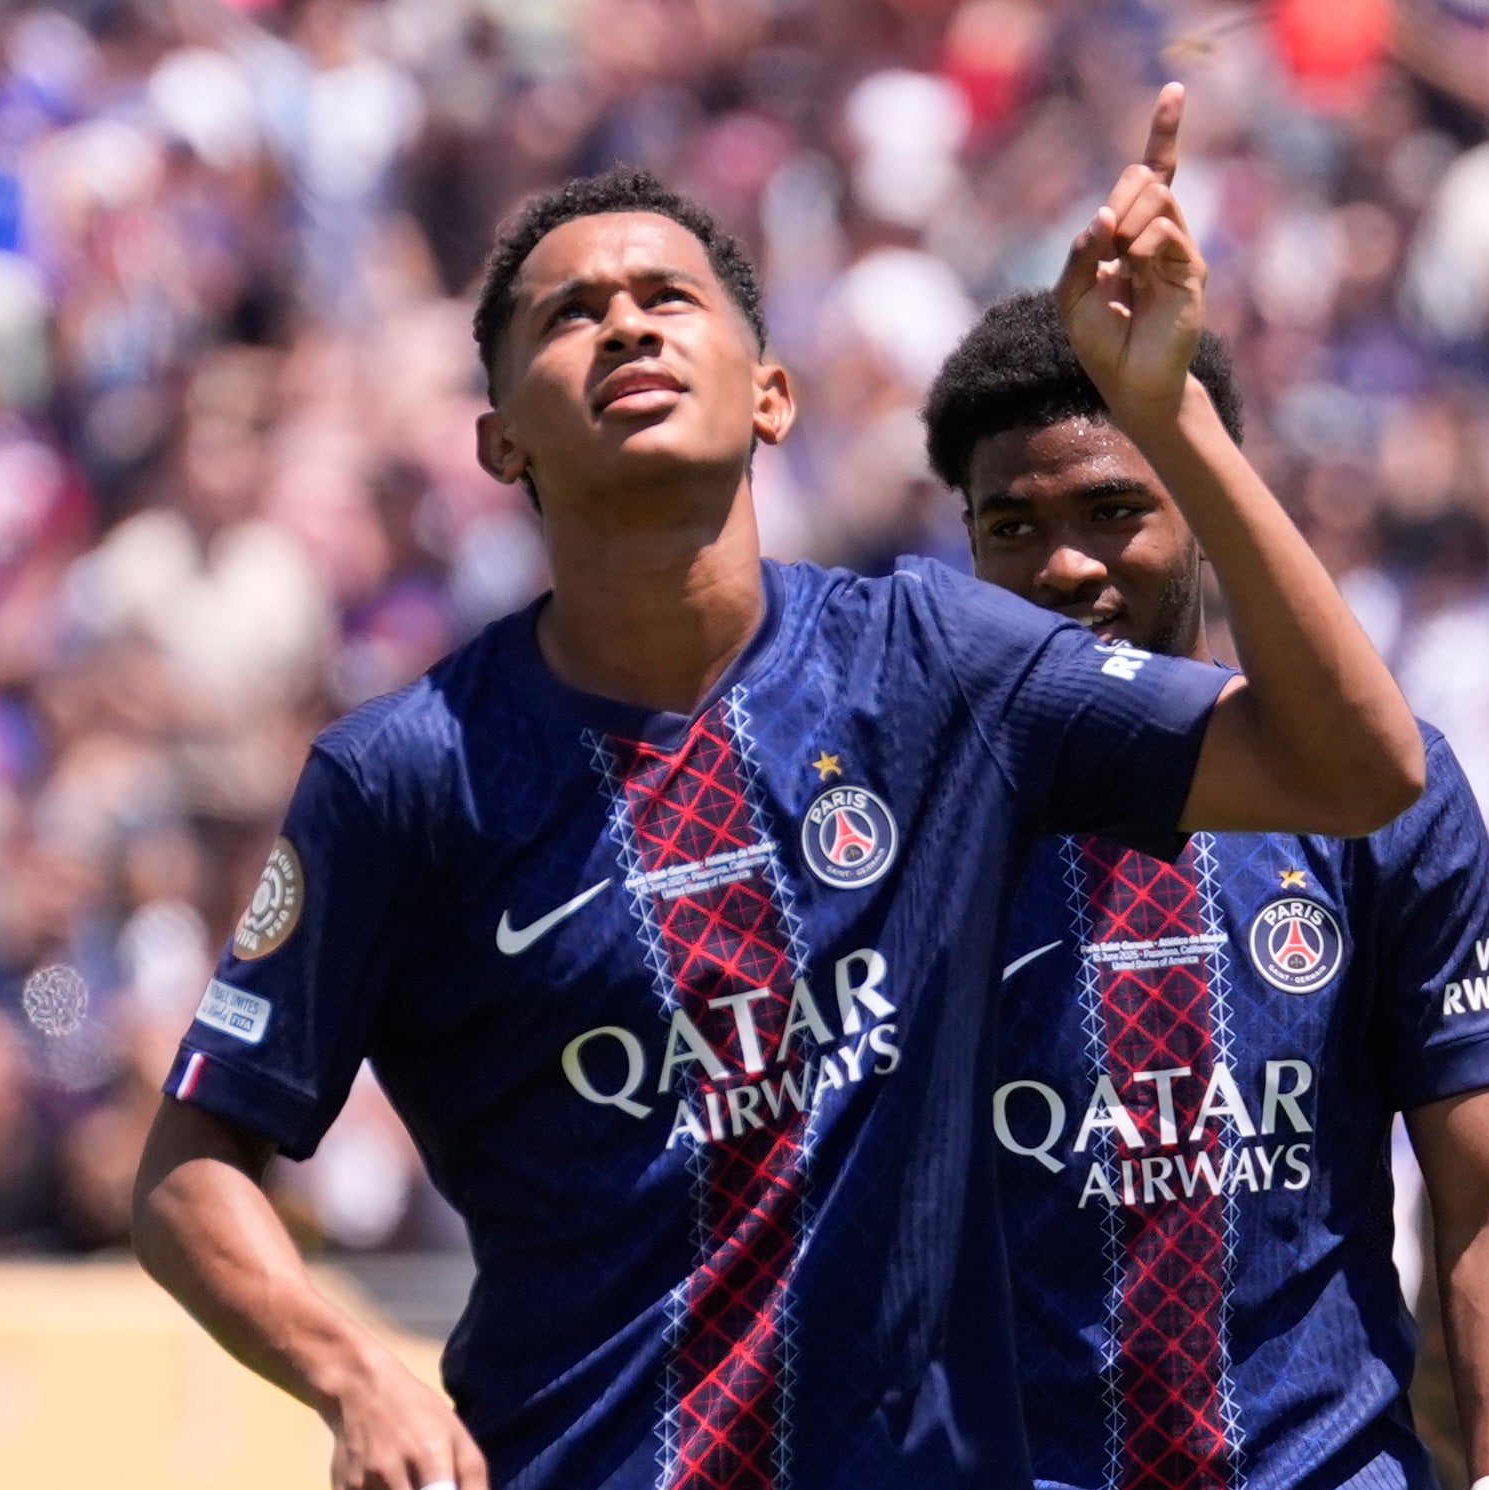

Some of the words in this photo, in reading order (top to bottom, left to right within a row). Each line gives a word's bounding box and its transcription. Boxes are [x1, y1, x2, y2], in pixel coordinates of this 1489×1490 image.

[810, 791, 867, 825] PARIS
[265, 909, 290, 938] USA
[1263, 902, 1325, 926] PARIS
[561, 947, 898, 1121] QATAR
[664, 1023, 901, 1150] AIRWAYS
[992, 1059, 1314, 1174] QATAR
[1077, 1142, 1313, 1209] AIRWAYS
